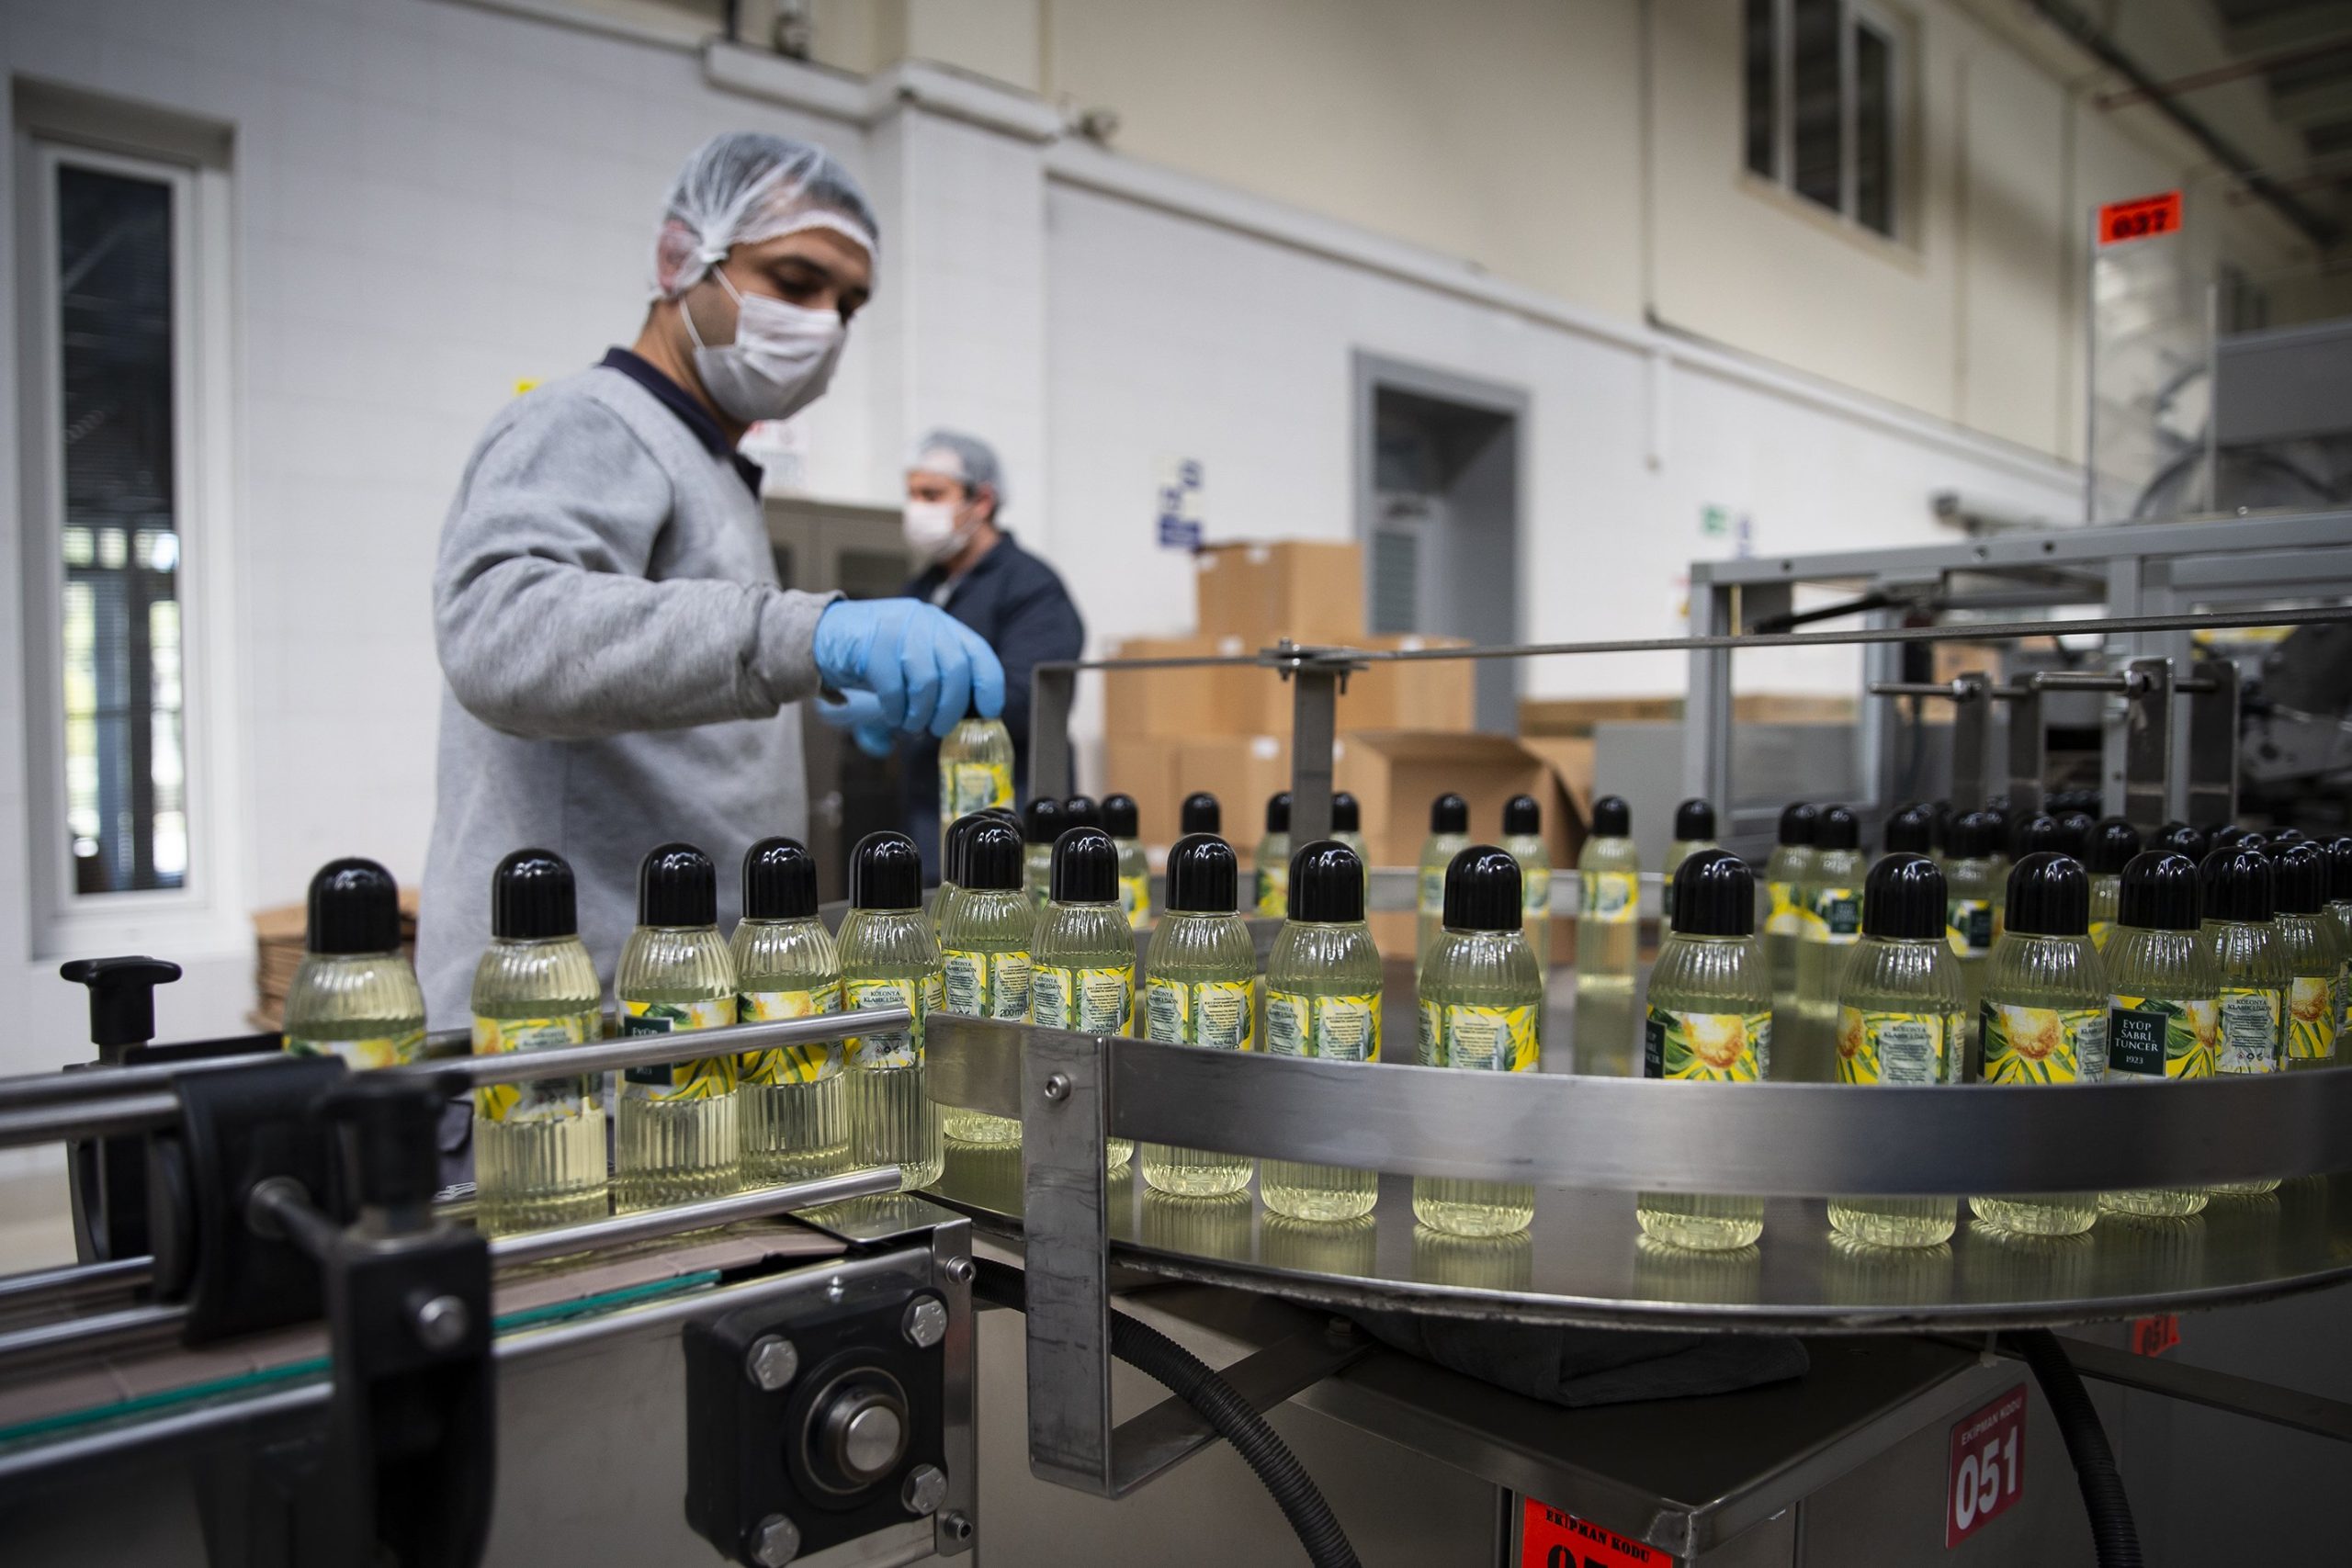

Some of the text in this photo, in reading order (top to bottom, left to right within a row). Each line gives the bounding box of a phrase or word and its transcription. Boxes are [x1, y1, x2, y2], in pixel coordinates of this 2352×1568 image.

[1000, 1009, 1014, 1017] 200
[2123, 1019, 2152, 1031] EYÜP
[2120, 1029, 2152, 1042] SABRİ
[2114, 1037, 2158, 1052] TUNCER
[2126, 1055, 2143, 1065] 1923
[1955, 1425, 2018, 1530] 051
[1611, 1536, 1651, 1563] KODU
